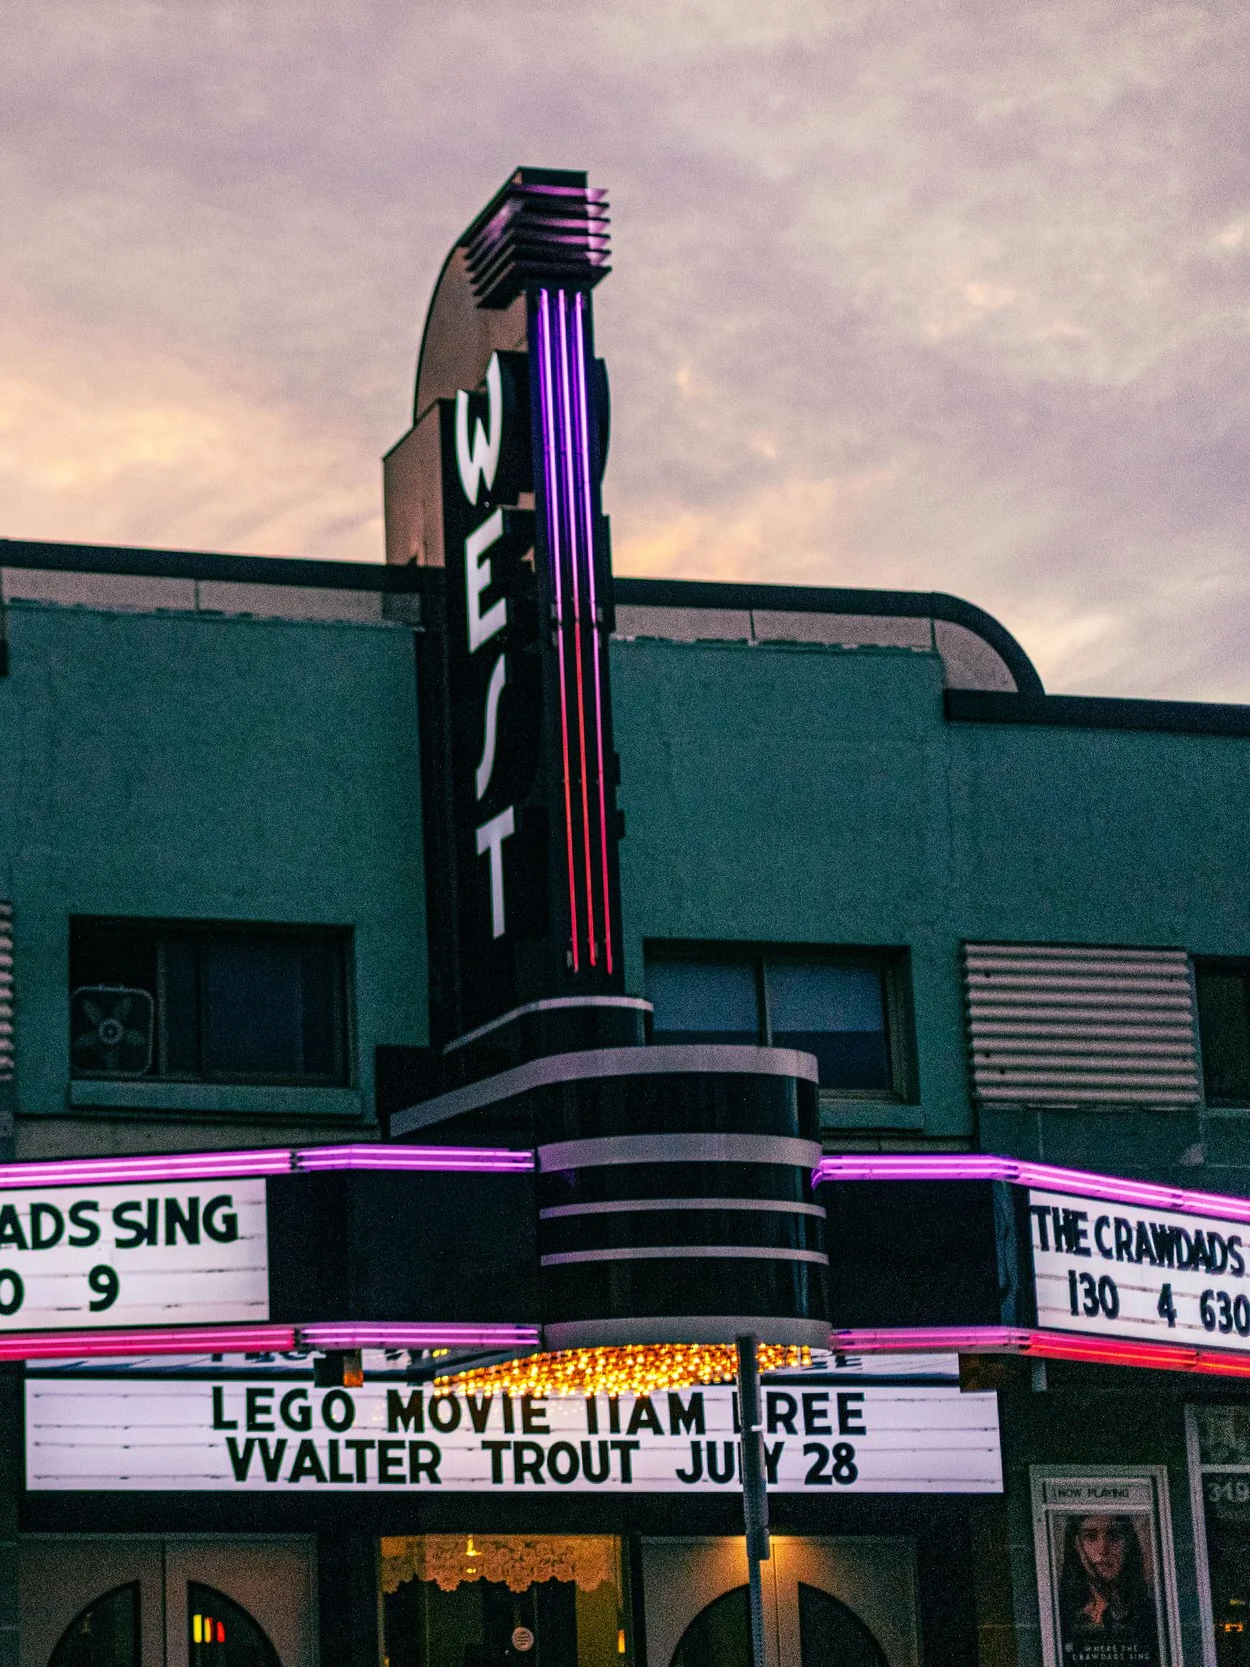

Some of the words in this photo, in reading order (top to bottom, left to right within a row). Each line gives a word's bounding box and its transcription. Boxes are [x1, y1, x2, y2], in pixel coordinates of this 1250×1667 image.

[455, 350, 515, 939] WEST
[112, 1194, 239, 1249] SING
[1030, 1205, 1092, 1257] THE
[1094, 1215, 1246, 1278] CRAWDADS
[87, 1263, 120, 1313] 9
[1068, 1269, 1120, 1321] 130
[1157, 1283, 1178, 1328] 4
[1200, 1288, 1250, 1338] 630
[212, 1386, 356, 1433] LEGO
[386, 1388, 551, 1435] MOVIE
[225, 1436, 442, 1485] WALTER
[481, 1440, 641, 1485] TROUT
[675, 1440, 785, 1485] JUY
[803, 1442, 859, 1486] 28
